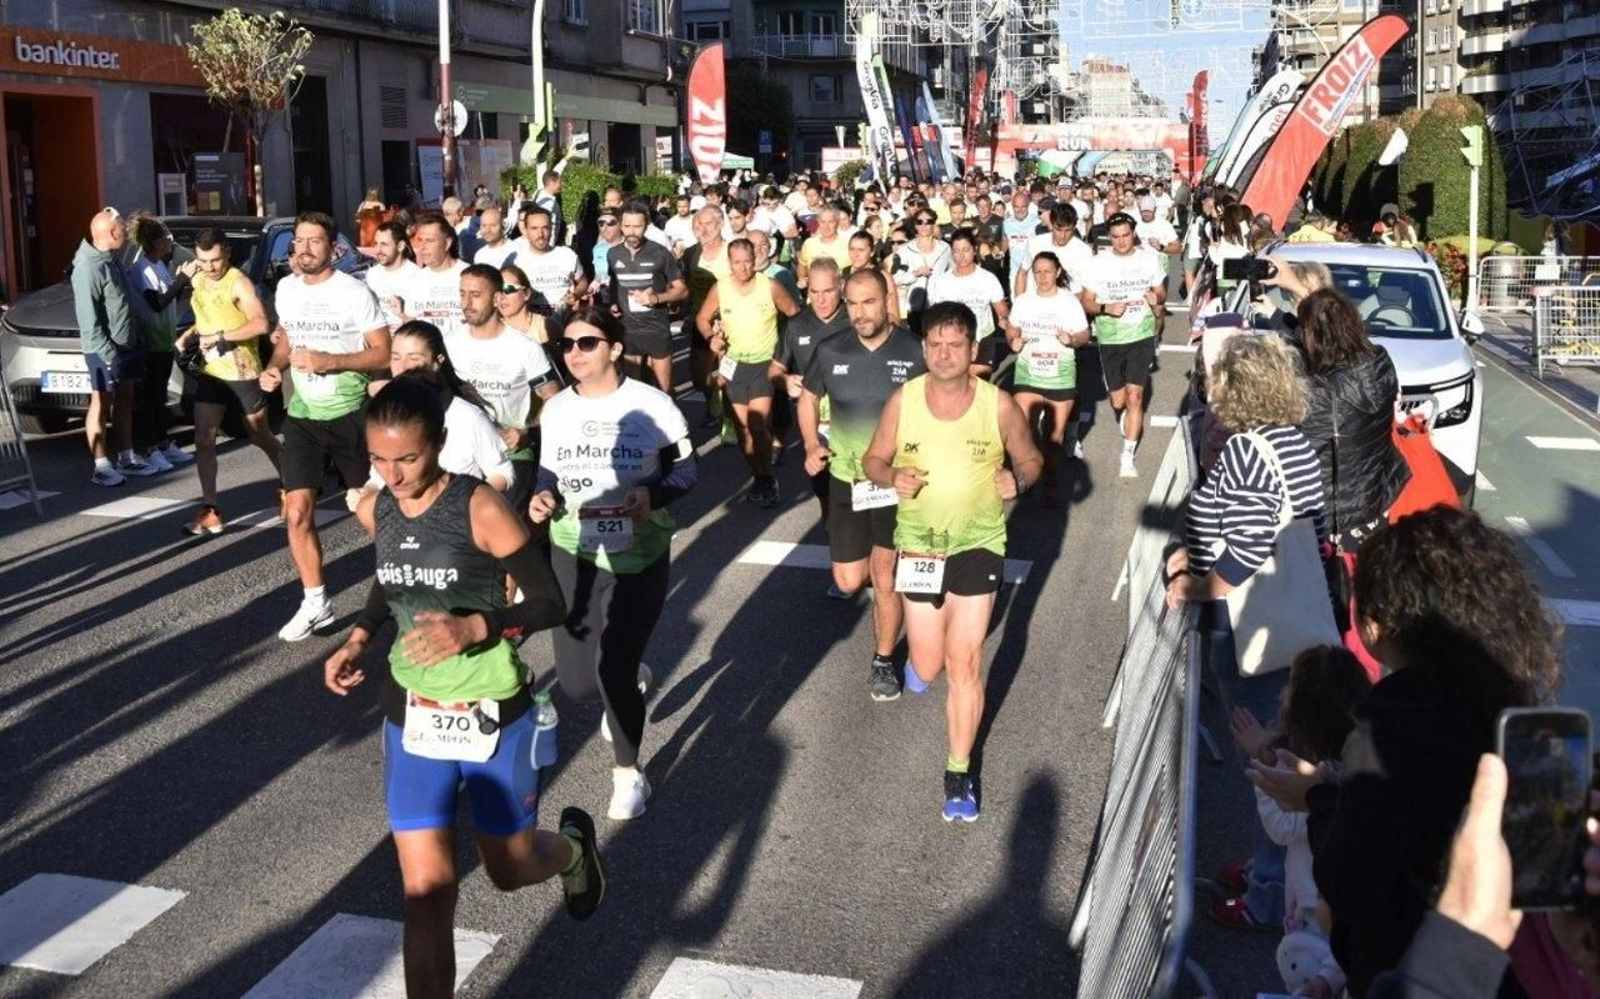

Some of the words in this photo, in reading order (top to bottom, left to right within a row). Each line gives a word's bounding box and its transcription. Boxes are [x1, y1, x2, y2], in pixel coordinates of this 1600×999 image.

[1300, 40, 1369, 125] FROIZ
[297, 320, 340, 331] Marcha
[576, 444, 643, 460] Marcha
[904, 443, 920, 452] DK
[597, 520, 624, 533] 521
[914, 561, 935, 573] 128
[415, 567, 459, 590] auga
[432, 714, 471, 732] 370
